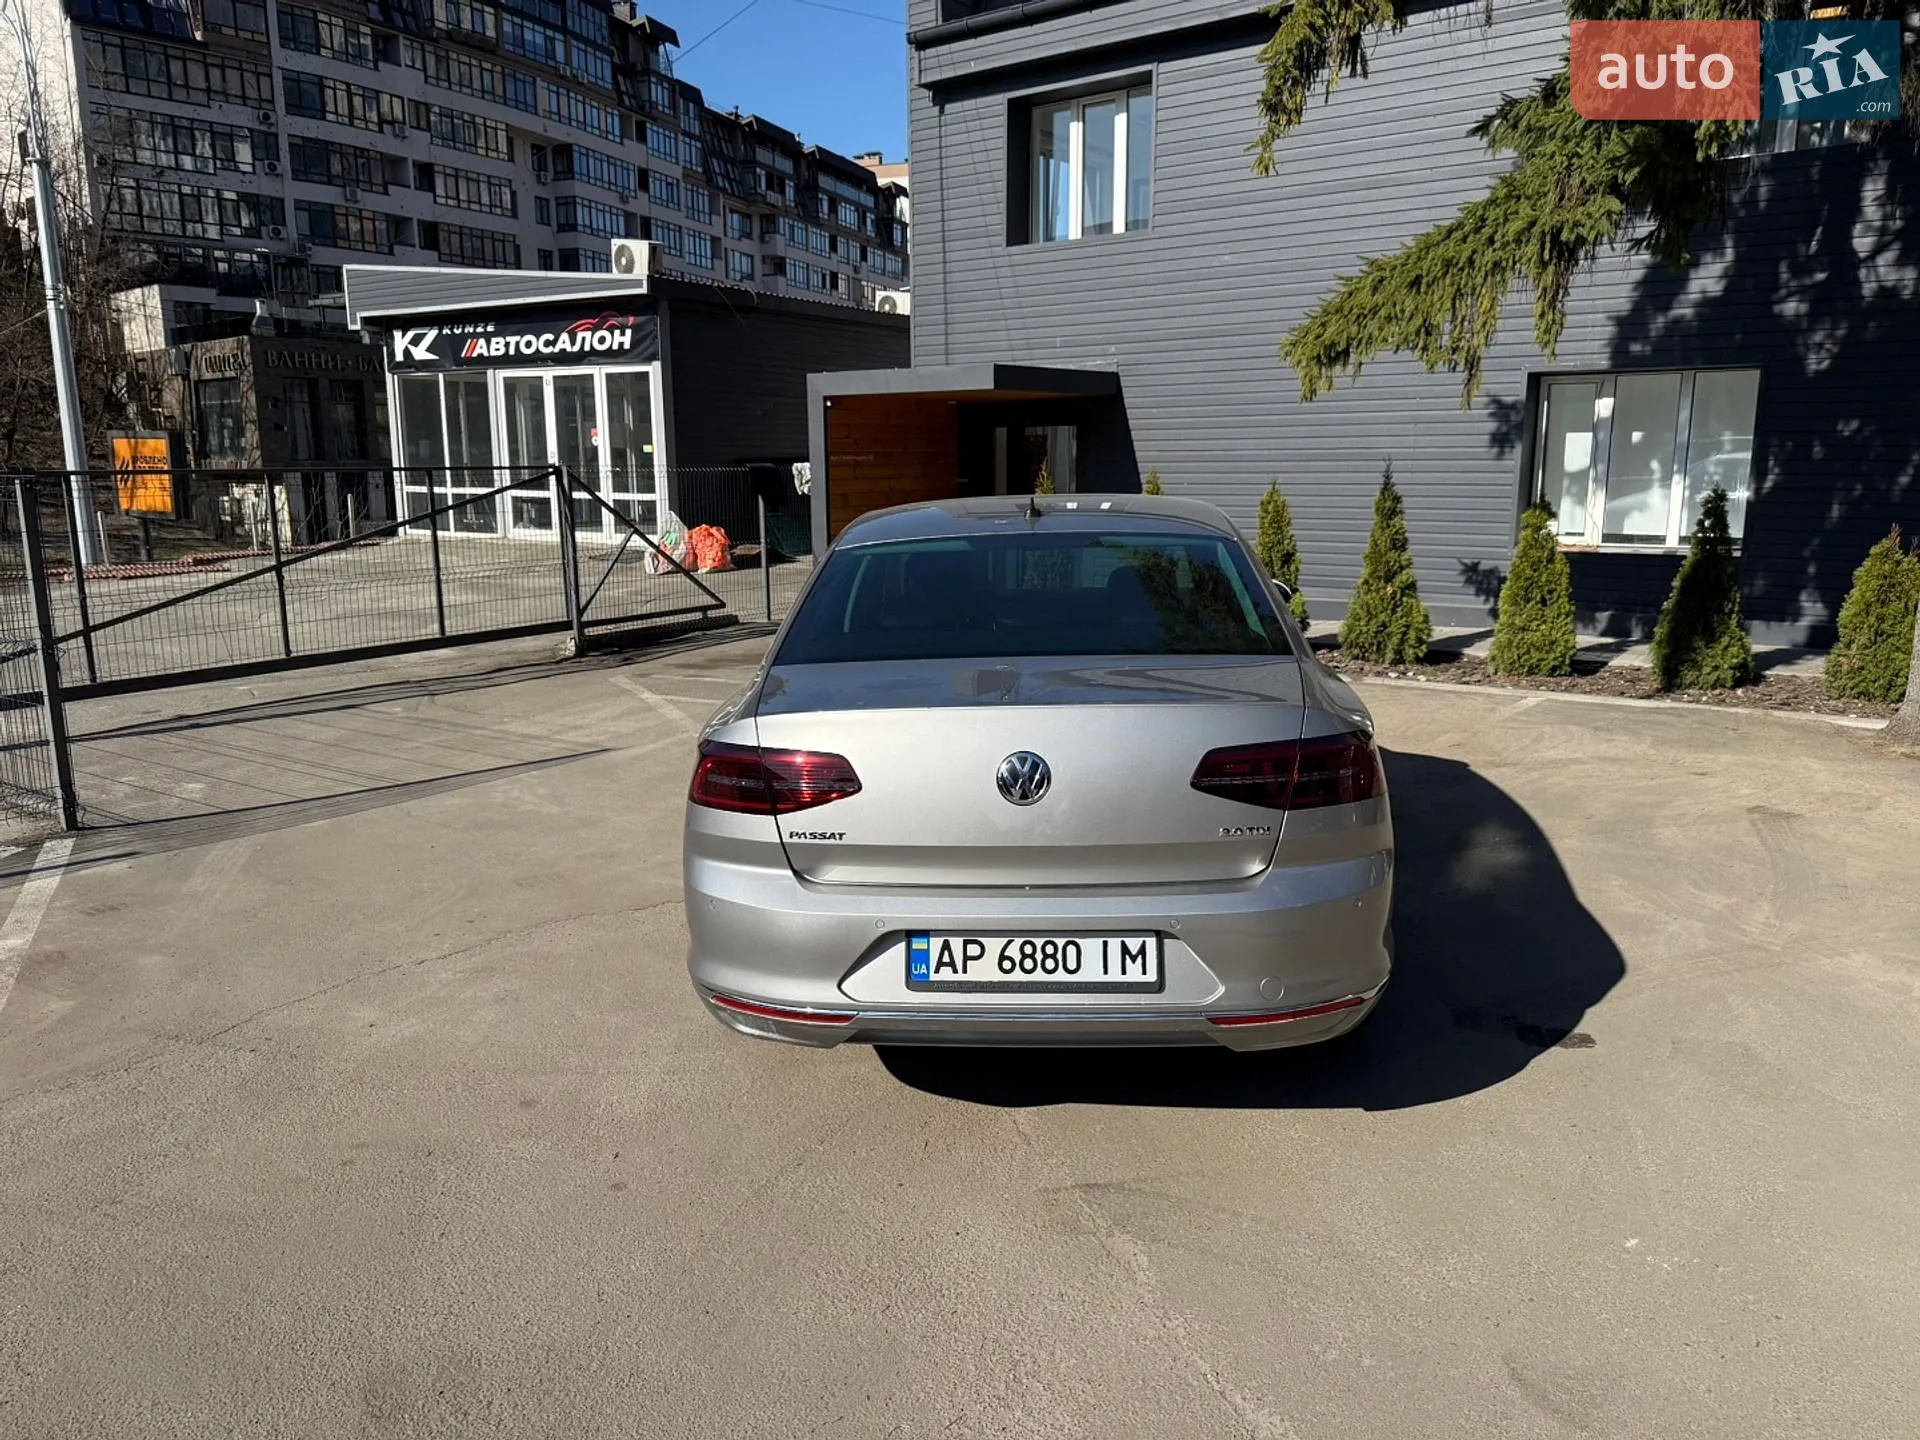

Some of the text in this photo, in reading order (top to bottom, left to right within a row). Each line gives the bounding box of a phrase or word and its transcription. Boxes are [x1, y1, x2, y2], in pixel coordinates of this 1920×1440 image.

[442, 322, 496, 335] KUNZE
[474, 329, 632, 357] АВТОСАЛОН
[266, 350, 344, 371] ВАННИ
[789, 831, 846, 841] PASSAT
[933, 938, 1147, 975] AP 6880 IM
[911, 962, 928, 975] UA
